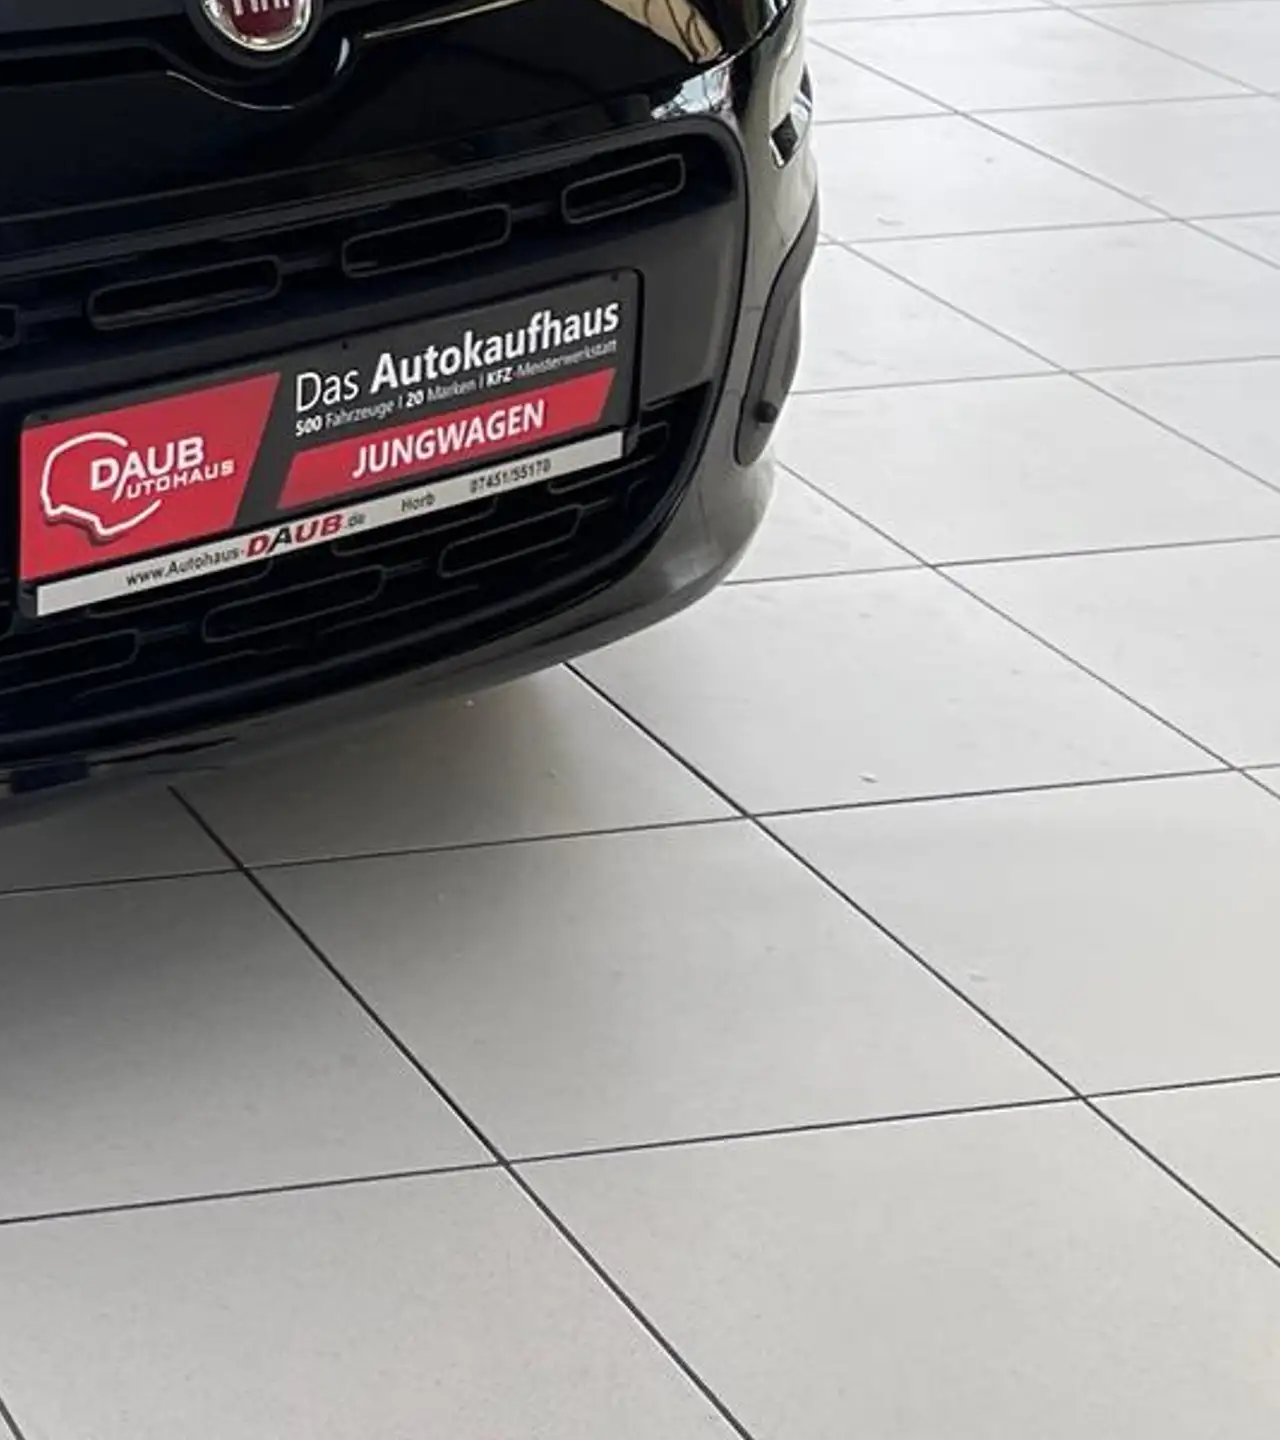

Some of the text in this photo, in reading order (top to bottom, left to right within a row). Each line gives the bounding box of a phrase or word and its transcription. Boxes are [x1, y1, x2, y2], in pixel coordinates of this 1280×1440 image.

[296, 302, 621, 412] Das Autokaufhaus
[295, 415, 323, 437] 500
[325, 400, 396, 429] Fahrzeuge
[406, 390, 425, 408] 20
[427, 377, 477, 402] Marken
[351, 399, 545, 479] JUNGWAGEN
[91, 436, 204, 502] DAUB
[401, 491, 436, 511] Horb
